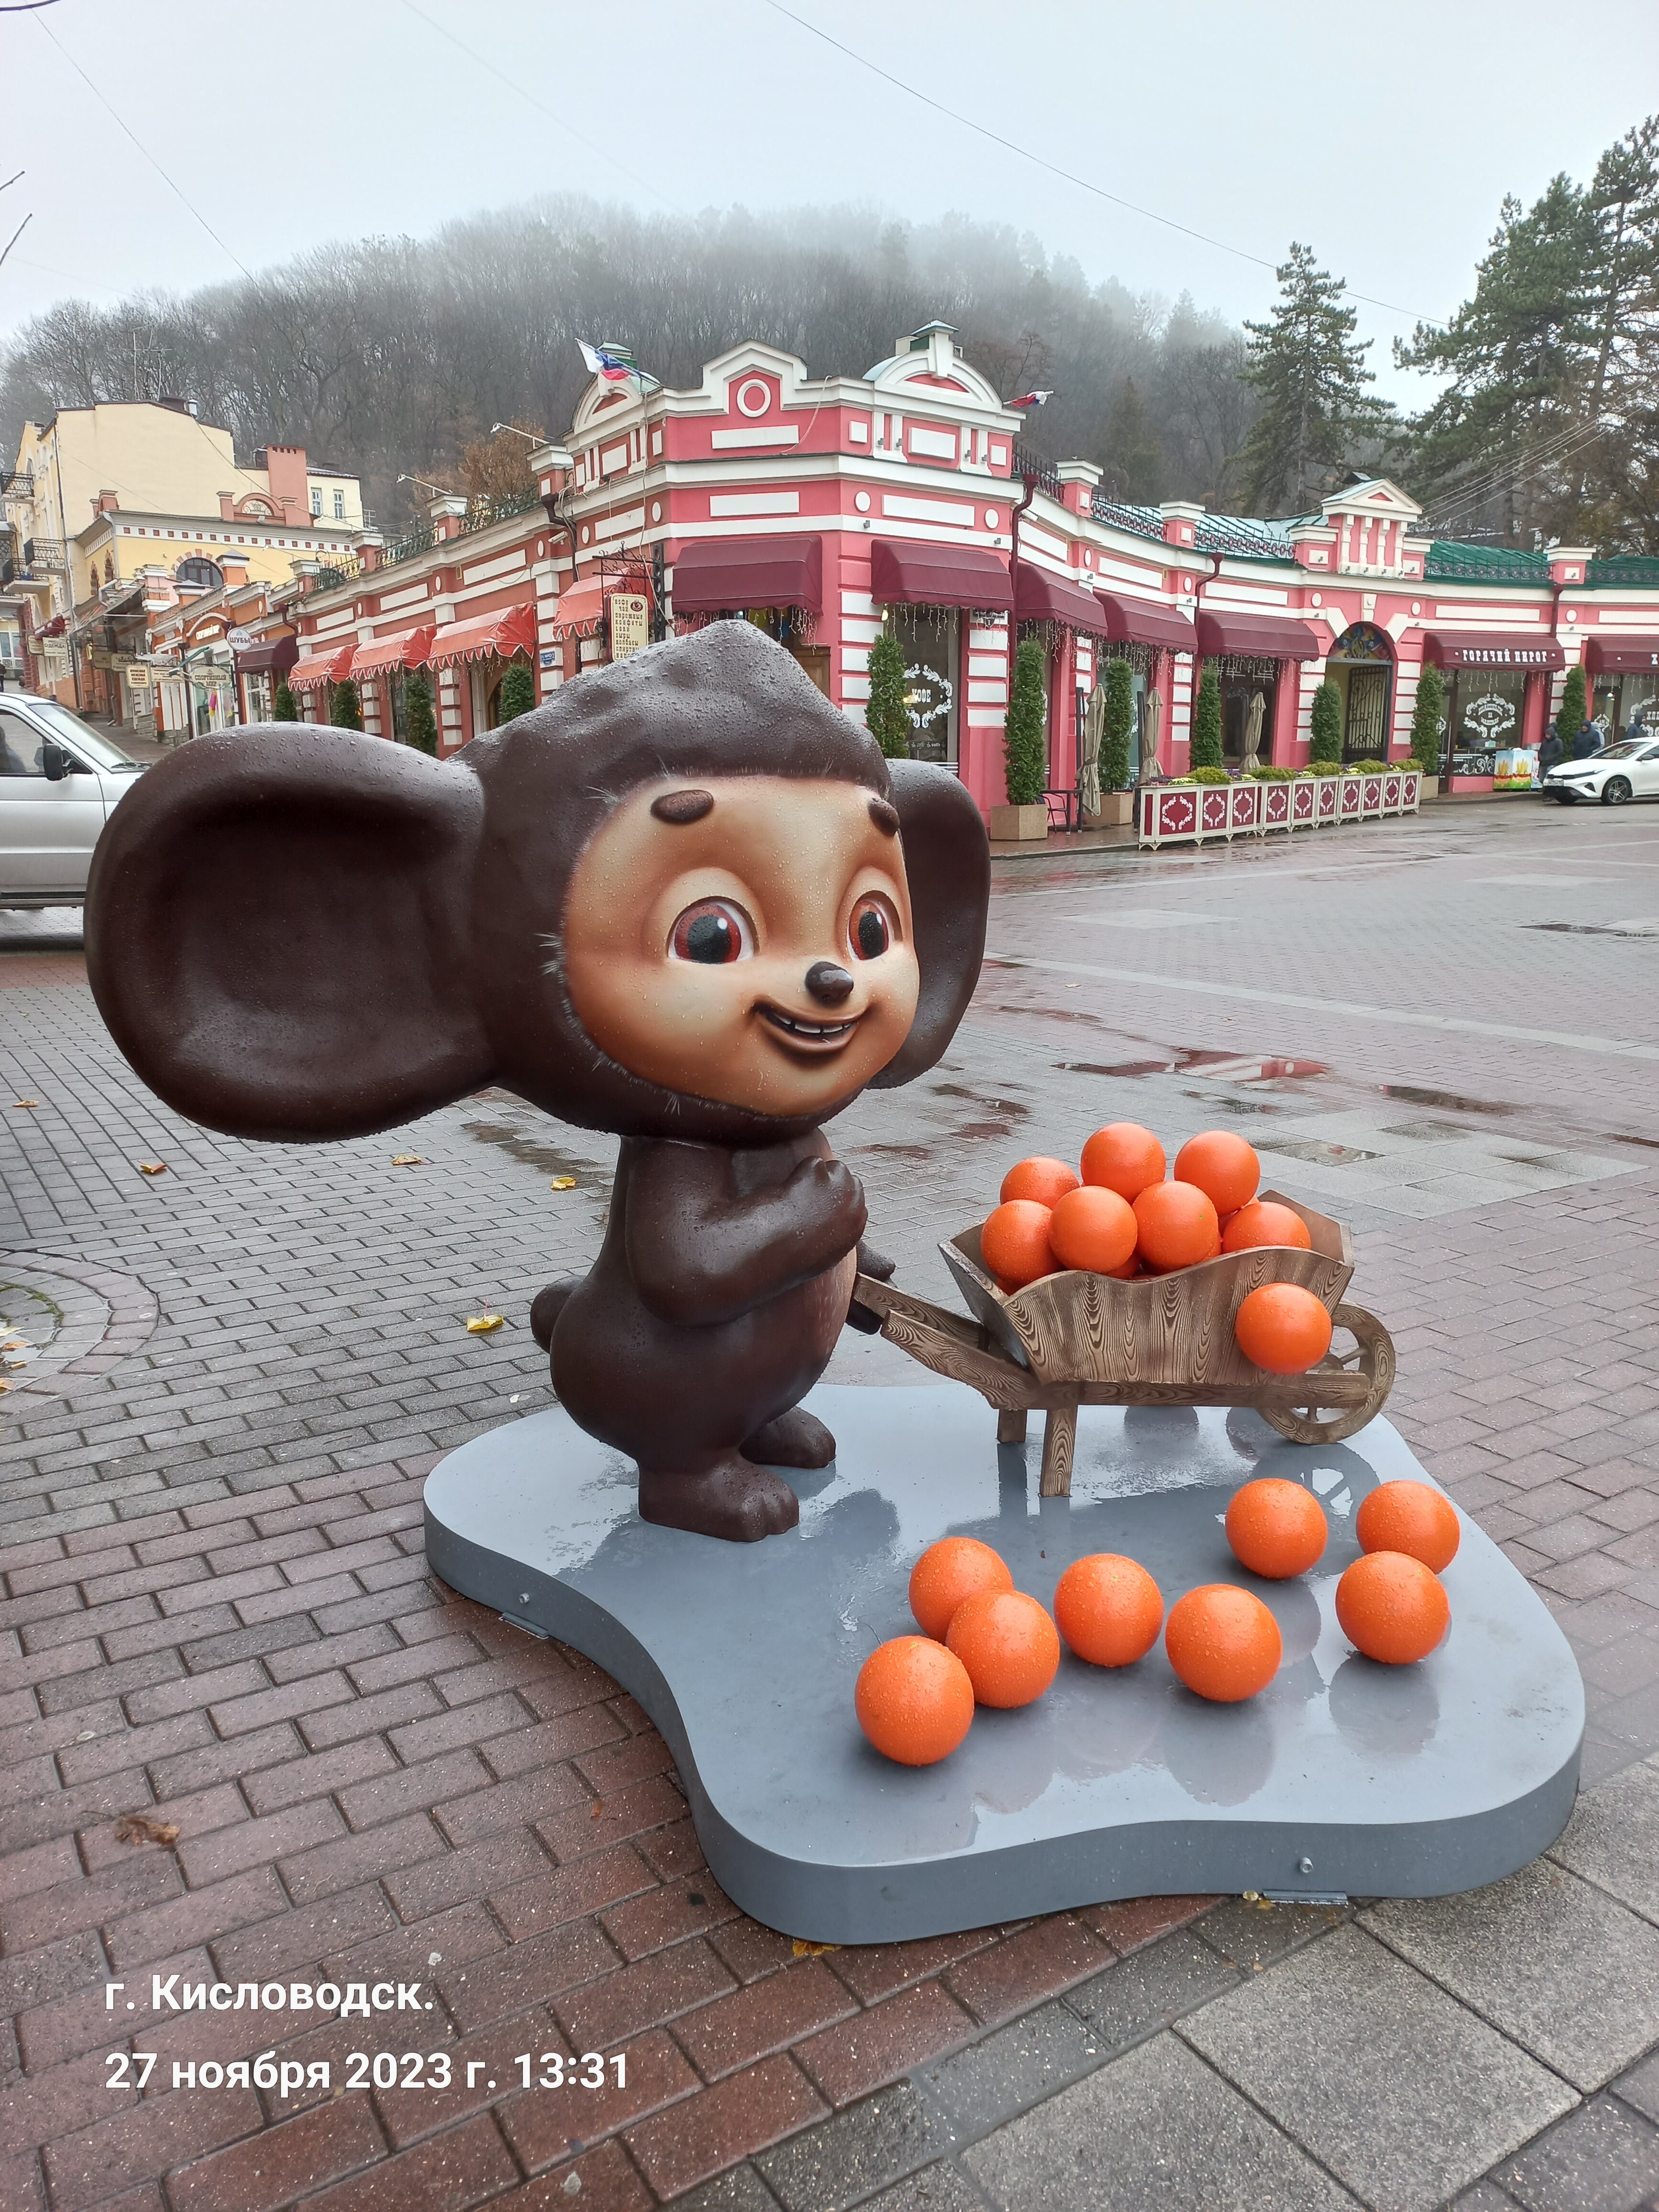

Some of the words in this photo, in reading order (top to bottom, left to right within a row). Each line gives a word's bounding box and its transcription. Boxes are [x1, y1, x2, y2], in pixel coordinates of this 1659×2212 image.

[1462, 648, 1511, 662] ГОРЯЧИЙ
[1514, 651, 1547, 663] ПИРОГ
[911, 688, 931, 703] КОФЕ
